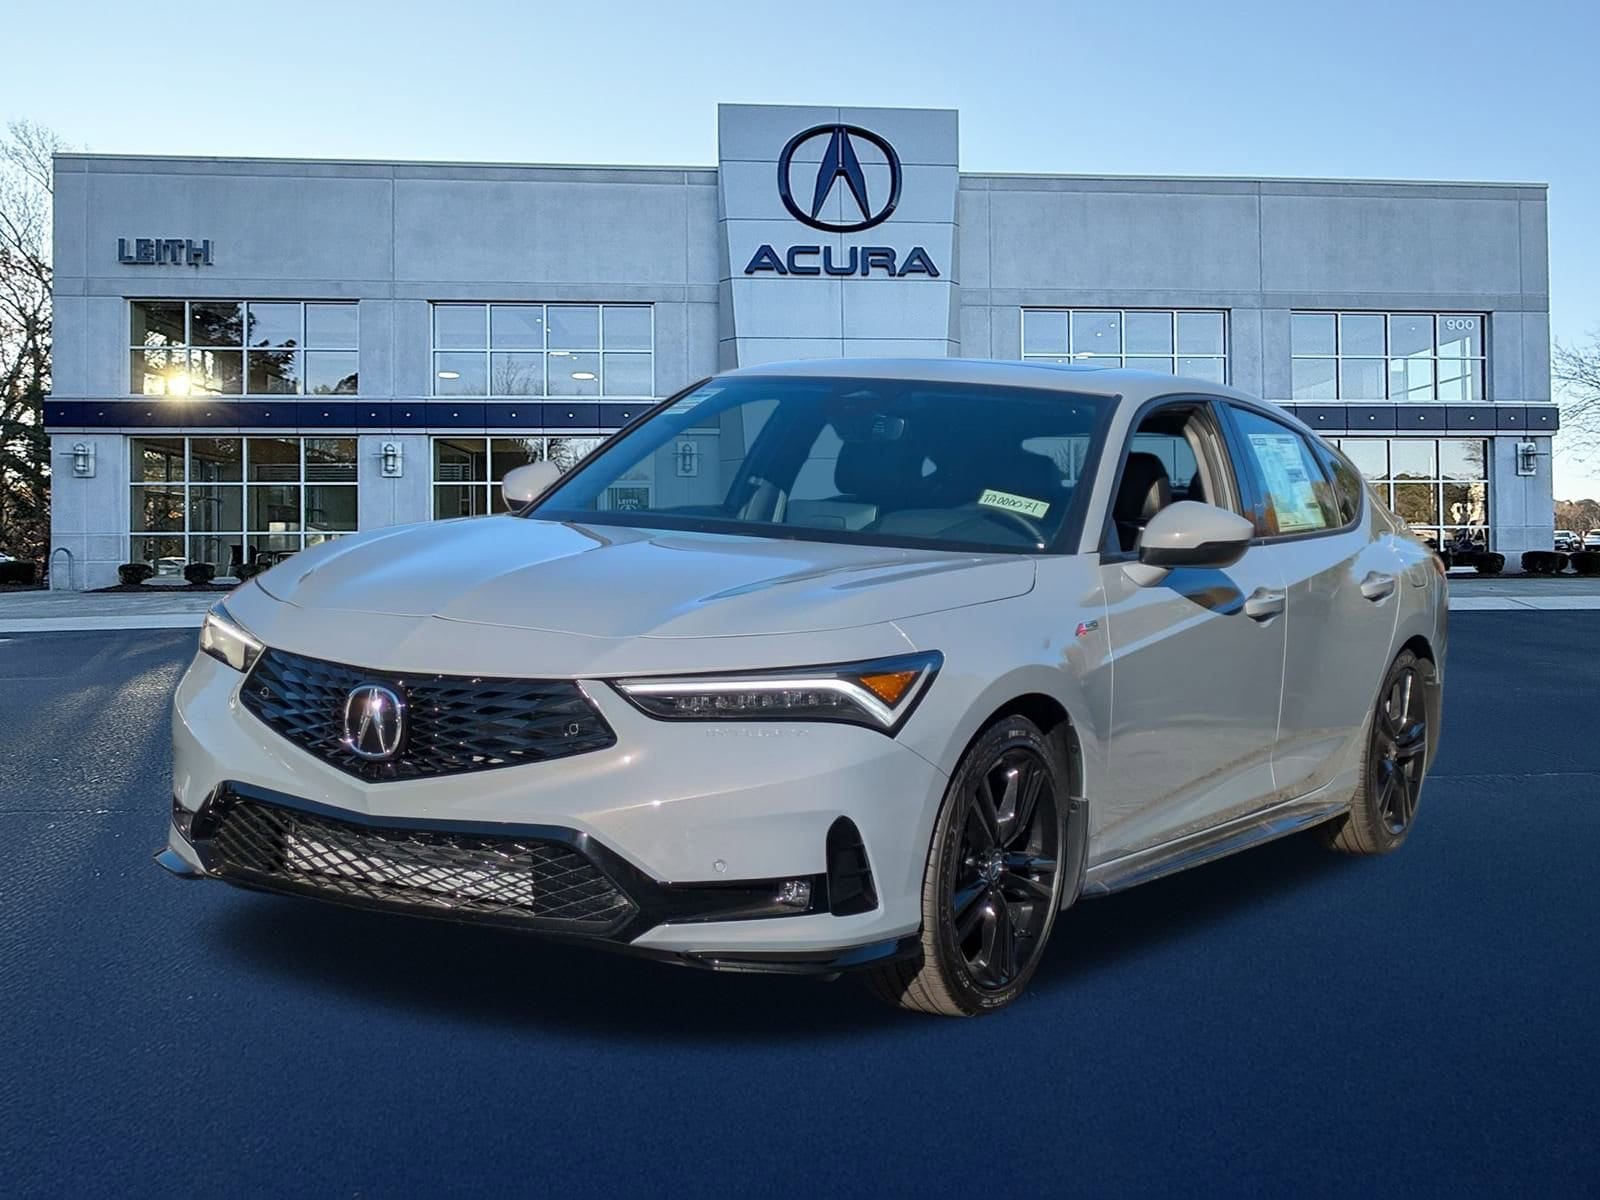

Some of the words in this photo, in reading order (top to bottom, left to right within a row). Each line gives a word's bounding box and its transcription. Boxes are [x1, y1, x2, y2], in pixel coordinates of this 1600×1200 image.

[118, 238, 210, 263] LEITH
[744, 244, 940, 277] ACURA
[1446, 319, 1474, 330] 900
